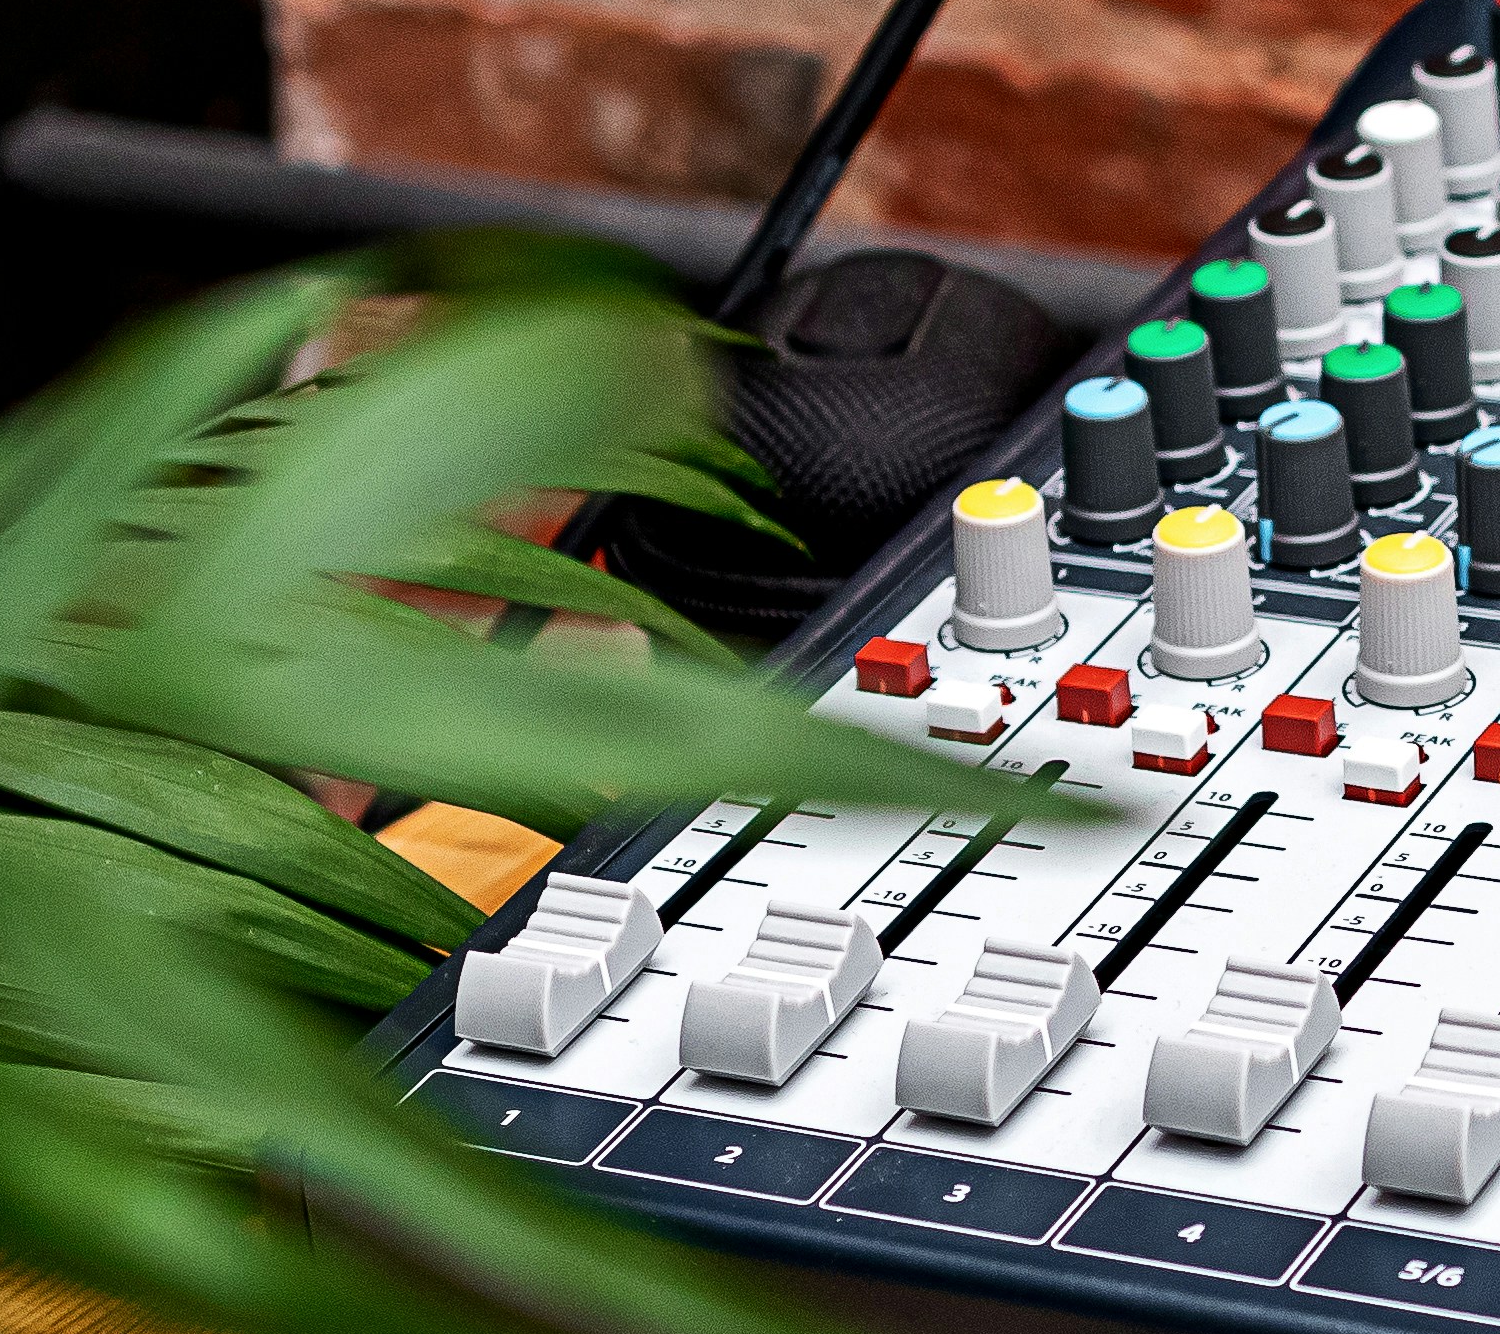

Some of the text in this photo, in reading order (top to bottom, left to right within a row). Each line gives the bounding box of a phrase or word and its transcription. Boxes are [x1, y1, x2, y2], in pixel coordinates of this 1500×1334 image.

[1191, 702, 1247, 718] PEAK
[1400, 731, 1457, 747] PEAK
[1000, 758, 1024, 771] 10
[1207, 791, 1232, 803] 10
[1422, 822, 1447, 834] 10
[662, 856, 698, 869] -10
[873, 890, 907, 902] -10
[1087, 922, 1123, 935] -10
[1306, 956, 1343, 969] -10
[501, 1109, 522, 1126] 1
[713, 1144, 743, 1165] 2
[942, 1182, 972, 1203] 3
[1176, 1222, 1205, 1244] 4
[1397, 1259, 1465, 1289] 5/6
